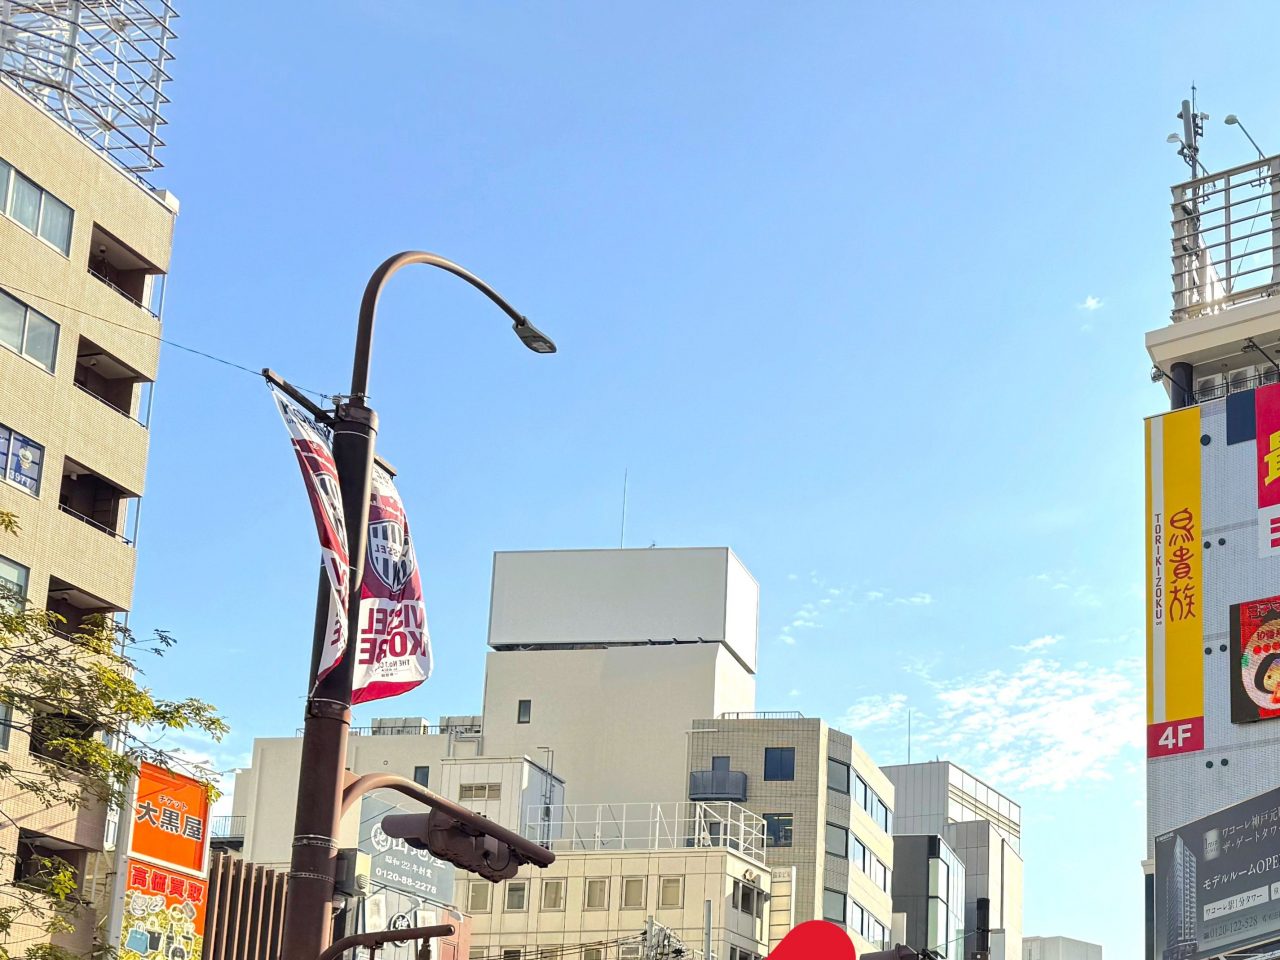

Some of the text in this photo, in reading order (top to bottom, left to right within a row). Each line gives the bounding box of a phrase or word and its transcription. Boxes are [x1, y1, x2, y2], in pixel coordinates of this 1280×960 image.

[1154, 512, 1163, 621] TORIKIZOKU
[1168, 507, 1195, 622] 鳥貴族
[1158, 723, 1193, 749] 4F
[136, 801, 203, 841] 大黒屋
[131, 865, 204, 904] 高価買取
[375, 867, 437, 894] 0120-88-2278
